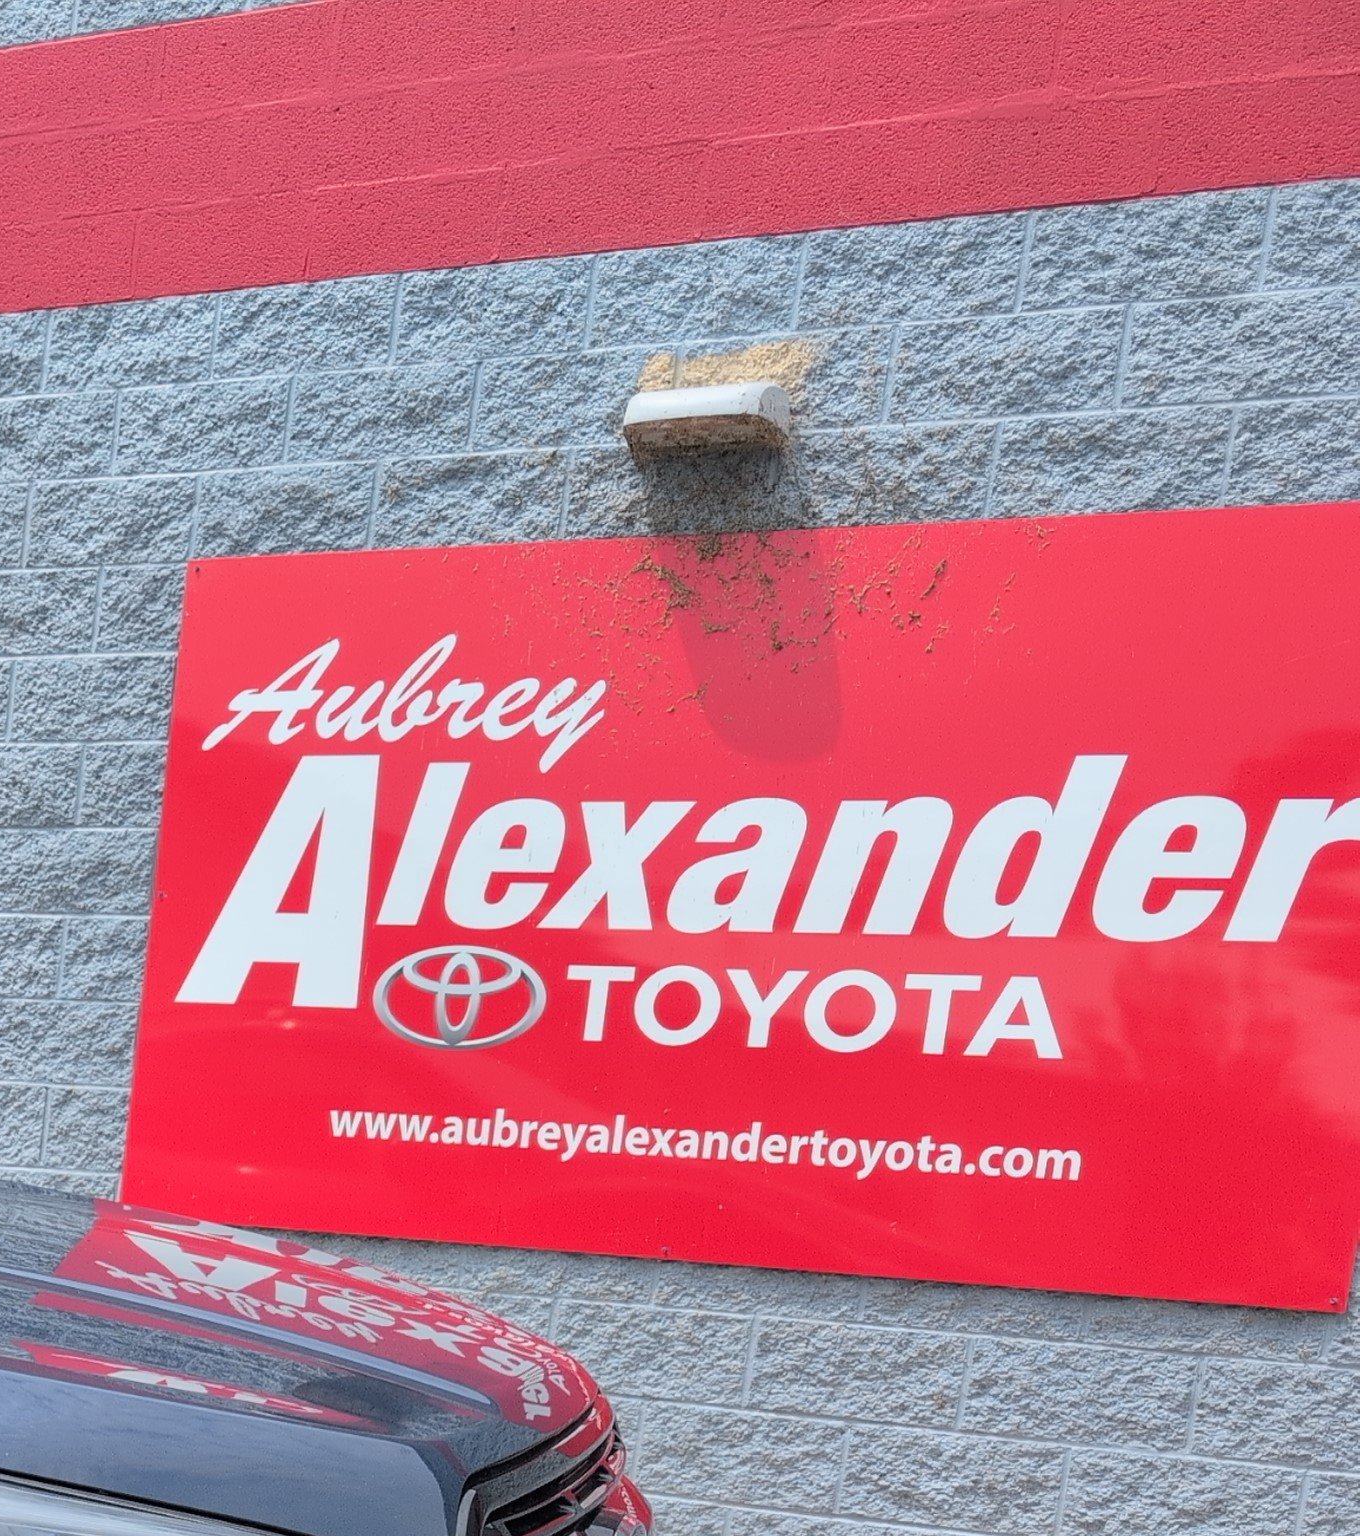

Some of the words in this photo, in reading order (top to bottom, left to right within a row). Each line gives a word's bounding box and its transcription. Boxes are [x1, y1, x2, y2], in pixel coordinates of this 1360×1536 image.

[202, 634, 606, 773] Aubrey
[175, 755, 1360, 1008] Alexander
[567, 965, 1062, 1058] TOYOTA
[331, 1109, 1081, 1180] www.aubreyalexandertoyota.com
